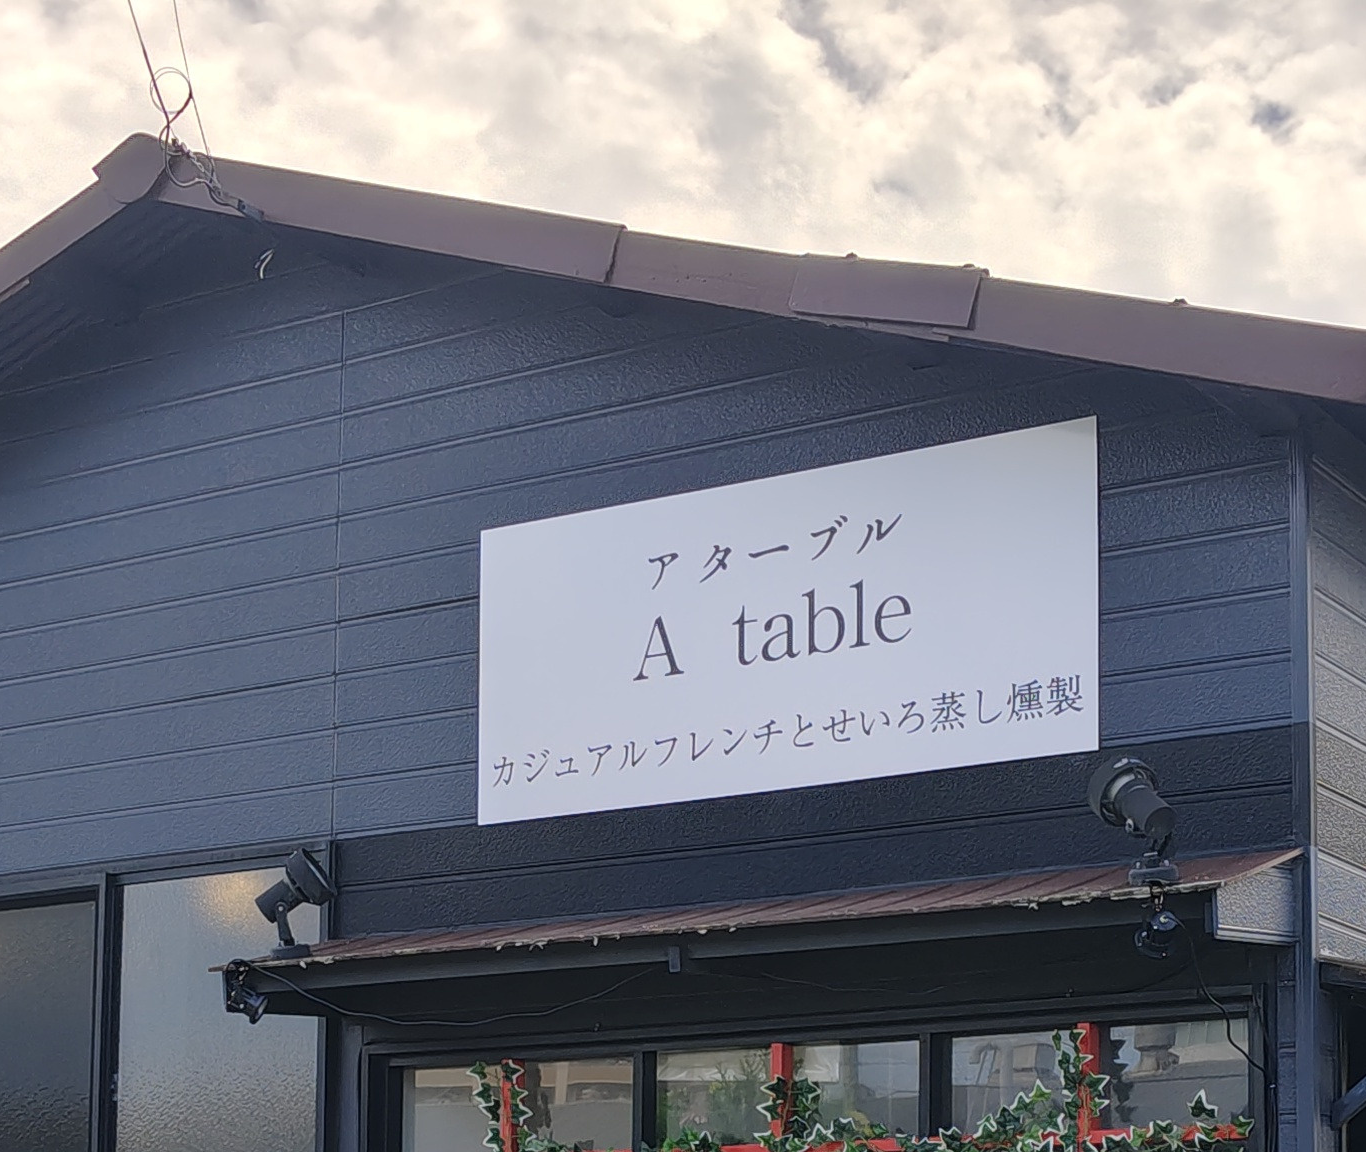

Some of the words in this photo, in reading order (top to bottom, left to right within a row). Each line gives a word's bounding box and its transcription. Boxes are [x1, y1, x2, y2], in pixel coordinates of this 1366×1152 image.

[647, 513, 903, 590] アターブル
[633, 615, 685, 682] A
[731, 579, 913, 667] table
[492, 674, 1084, 788] カジュアルフレンチとせいろ蒸し燻製
